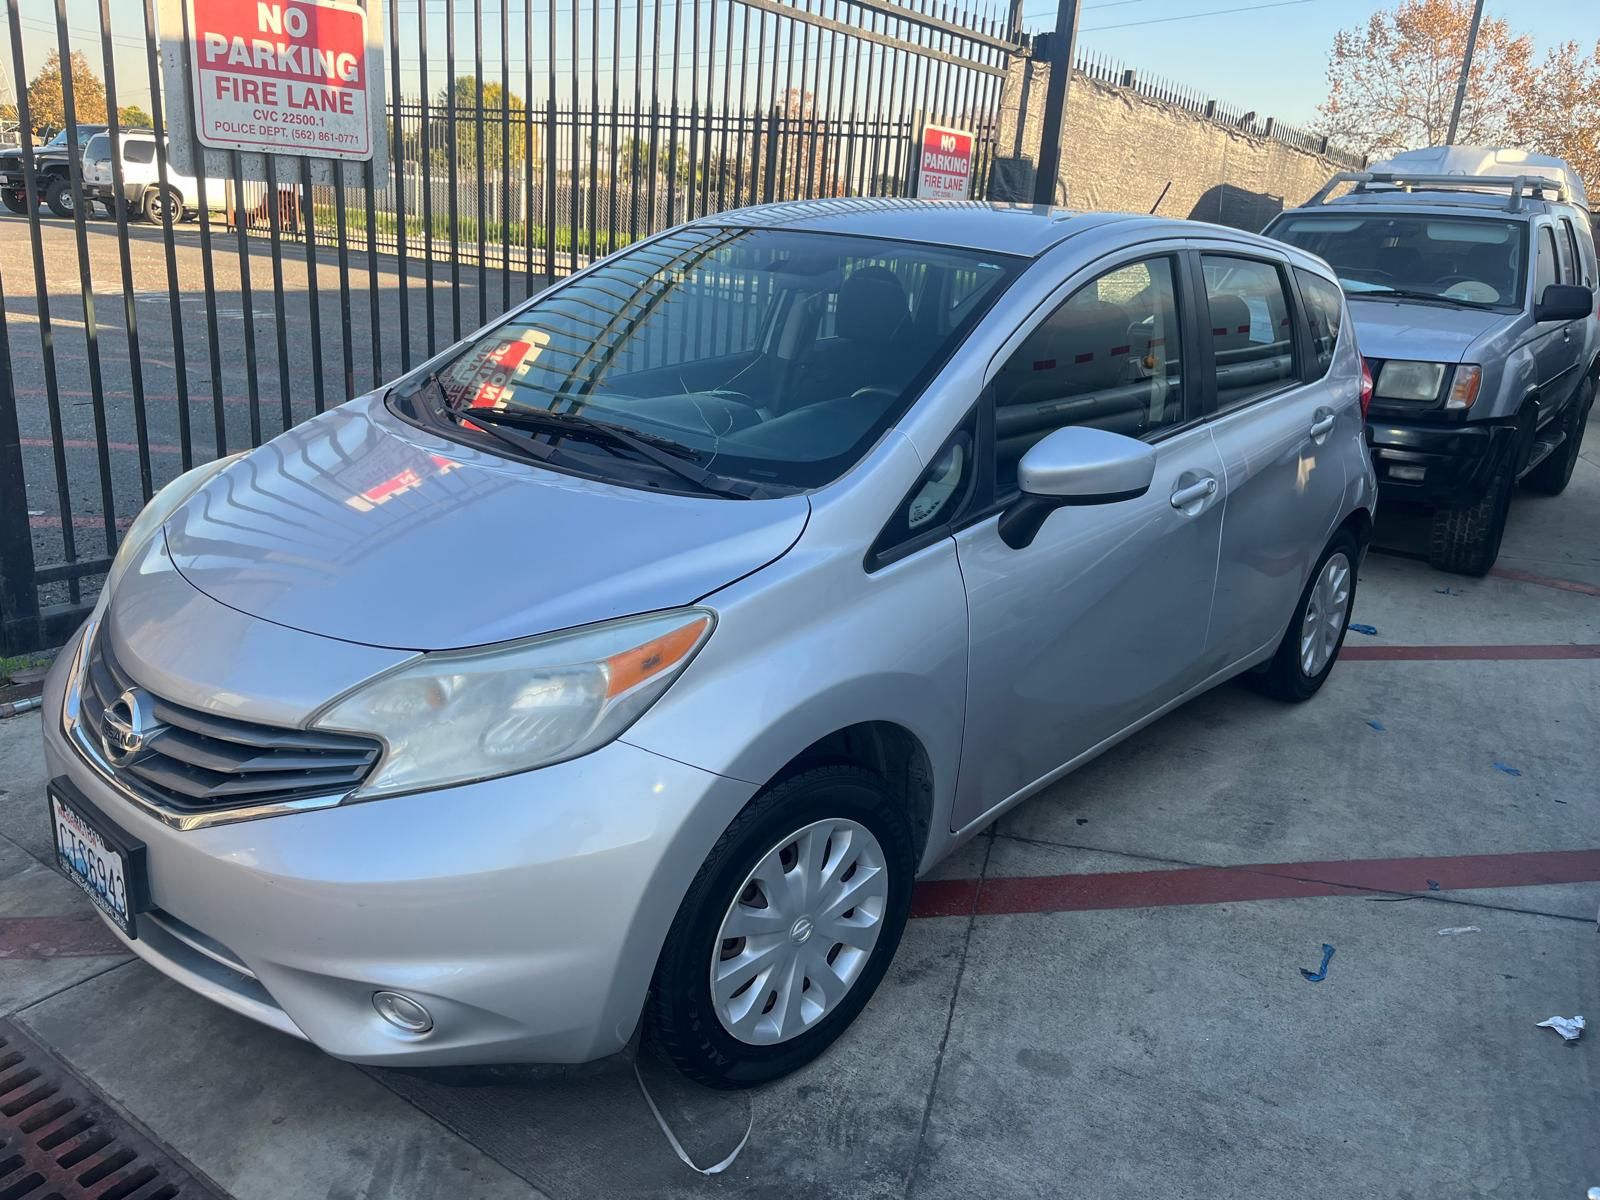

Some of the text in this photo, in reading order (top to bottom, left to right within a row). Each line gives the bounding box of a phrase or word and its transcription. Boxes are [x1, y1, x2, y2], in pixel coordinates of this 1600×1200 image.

[257, 2, 308, 38] NO
[204, 31, 359, 82] PARKING
[215, 76, 354, 115] FIRE LANE
[253, 109, 325, 127] CVC 22500.1
[215, 121, 359, 144] POLICE DEPT. (562) 861-0771
[941, 135, 956, 152] NO
[924, 152, 967, 173] PARKING
[924, 175, 963, 191] FIRE LANE
[60, 822, 127, 918] CTS6943
